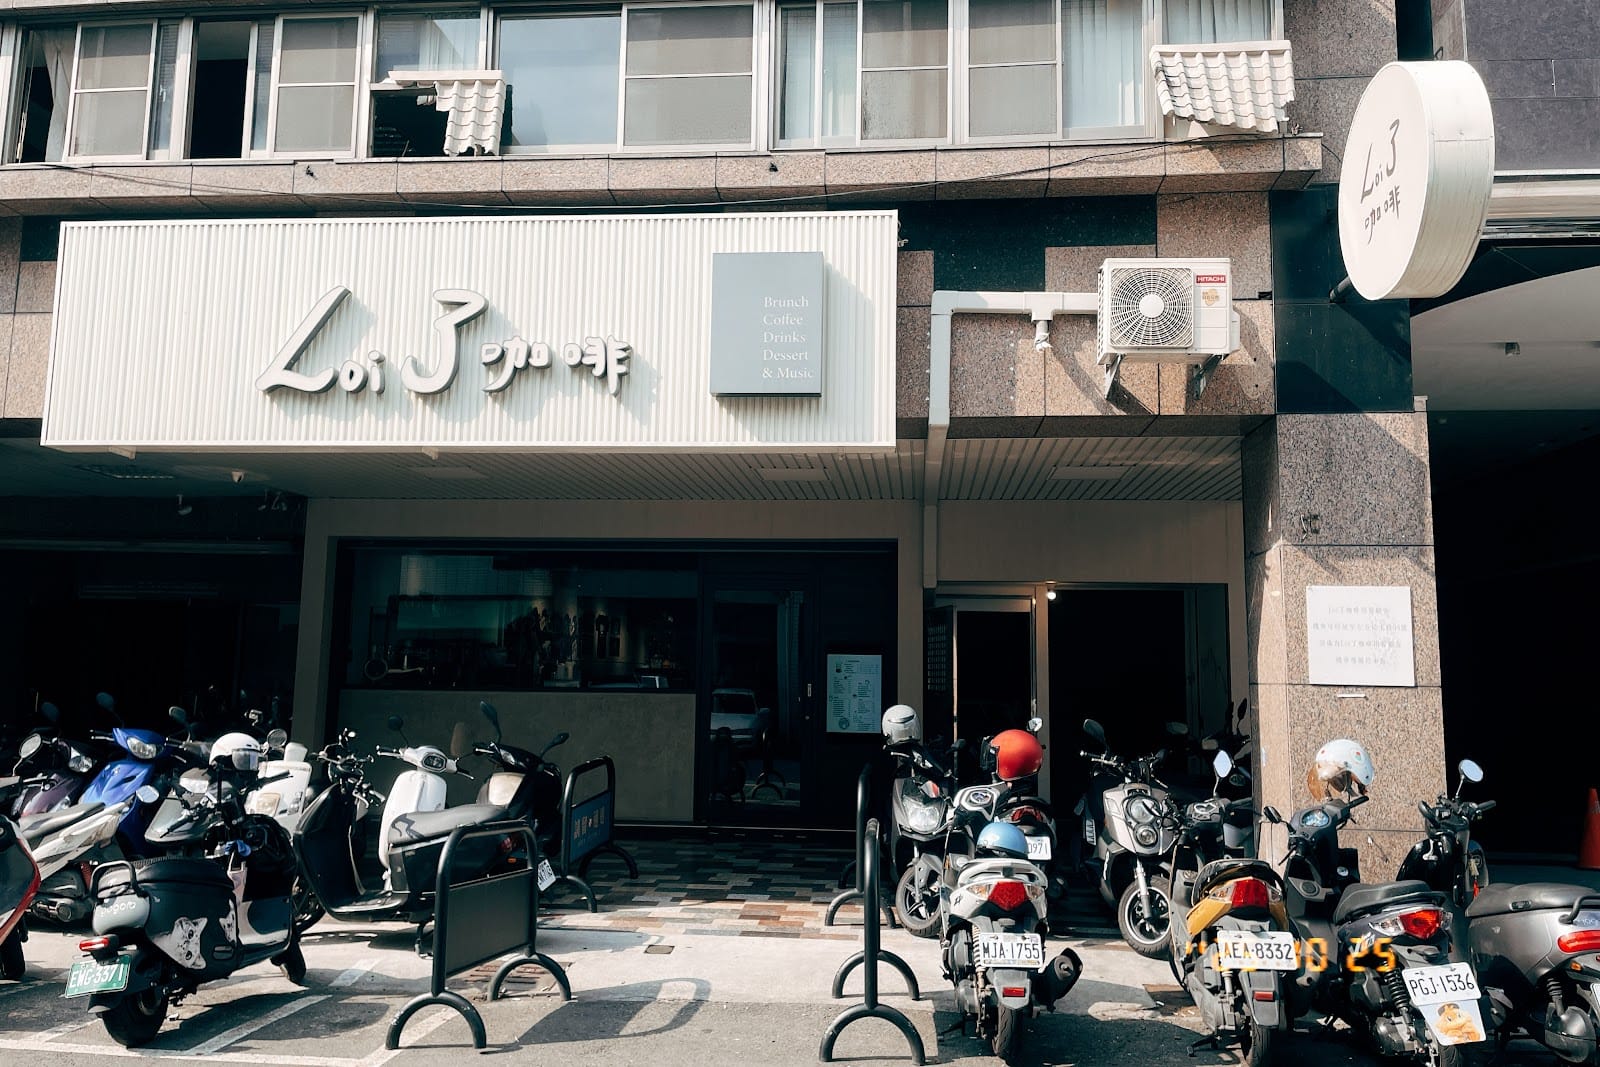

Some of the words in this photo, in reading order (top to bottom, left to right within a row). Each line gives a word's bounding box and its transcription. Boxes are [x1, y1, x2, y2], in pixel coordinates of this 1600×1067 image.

[1364, 184, 1400, 245] 咖啡
[1197, 275, 1225, 283] HITACHI
[763, 295, 809, 308] Brunch
[763, 313, 804, 325] Coffee
[763, 331, 807, 343] Drinks
[763, 349, 809, 361] Dessert
[762, 367, 773, 378] &
[777, 367, 815, 378] Music
